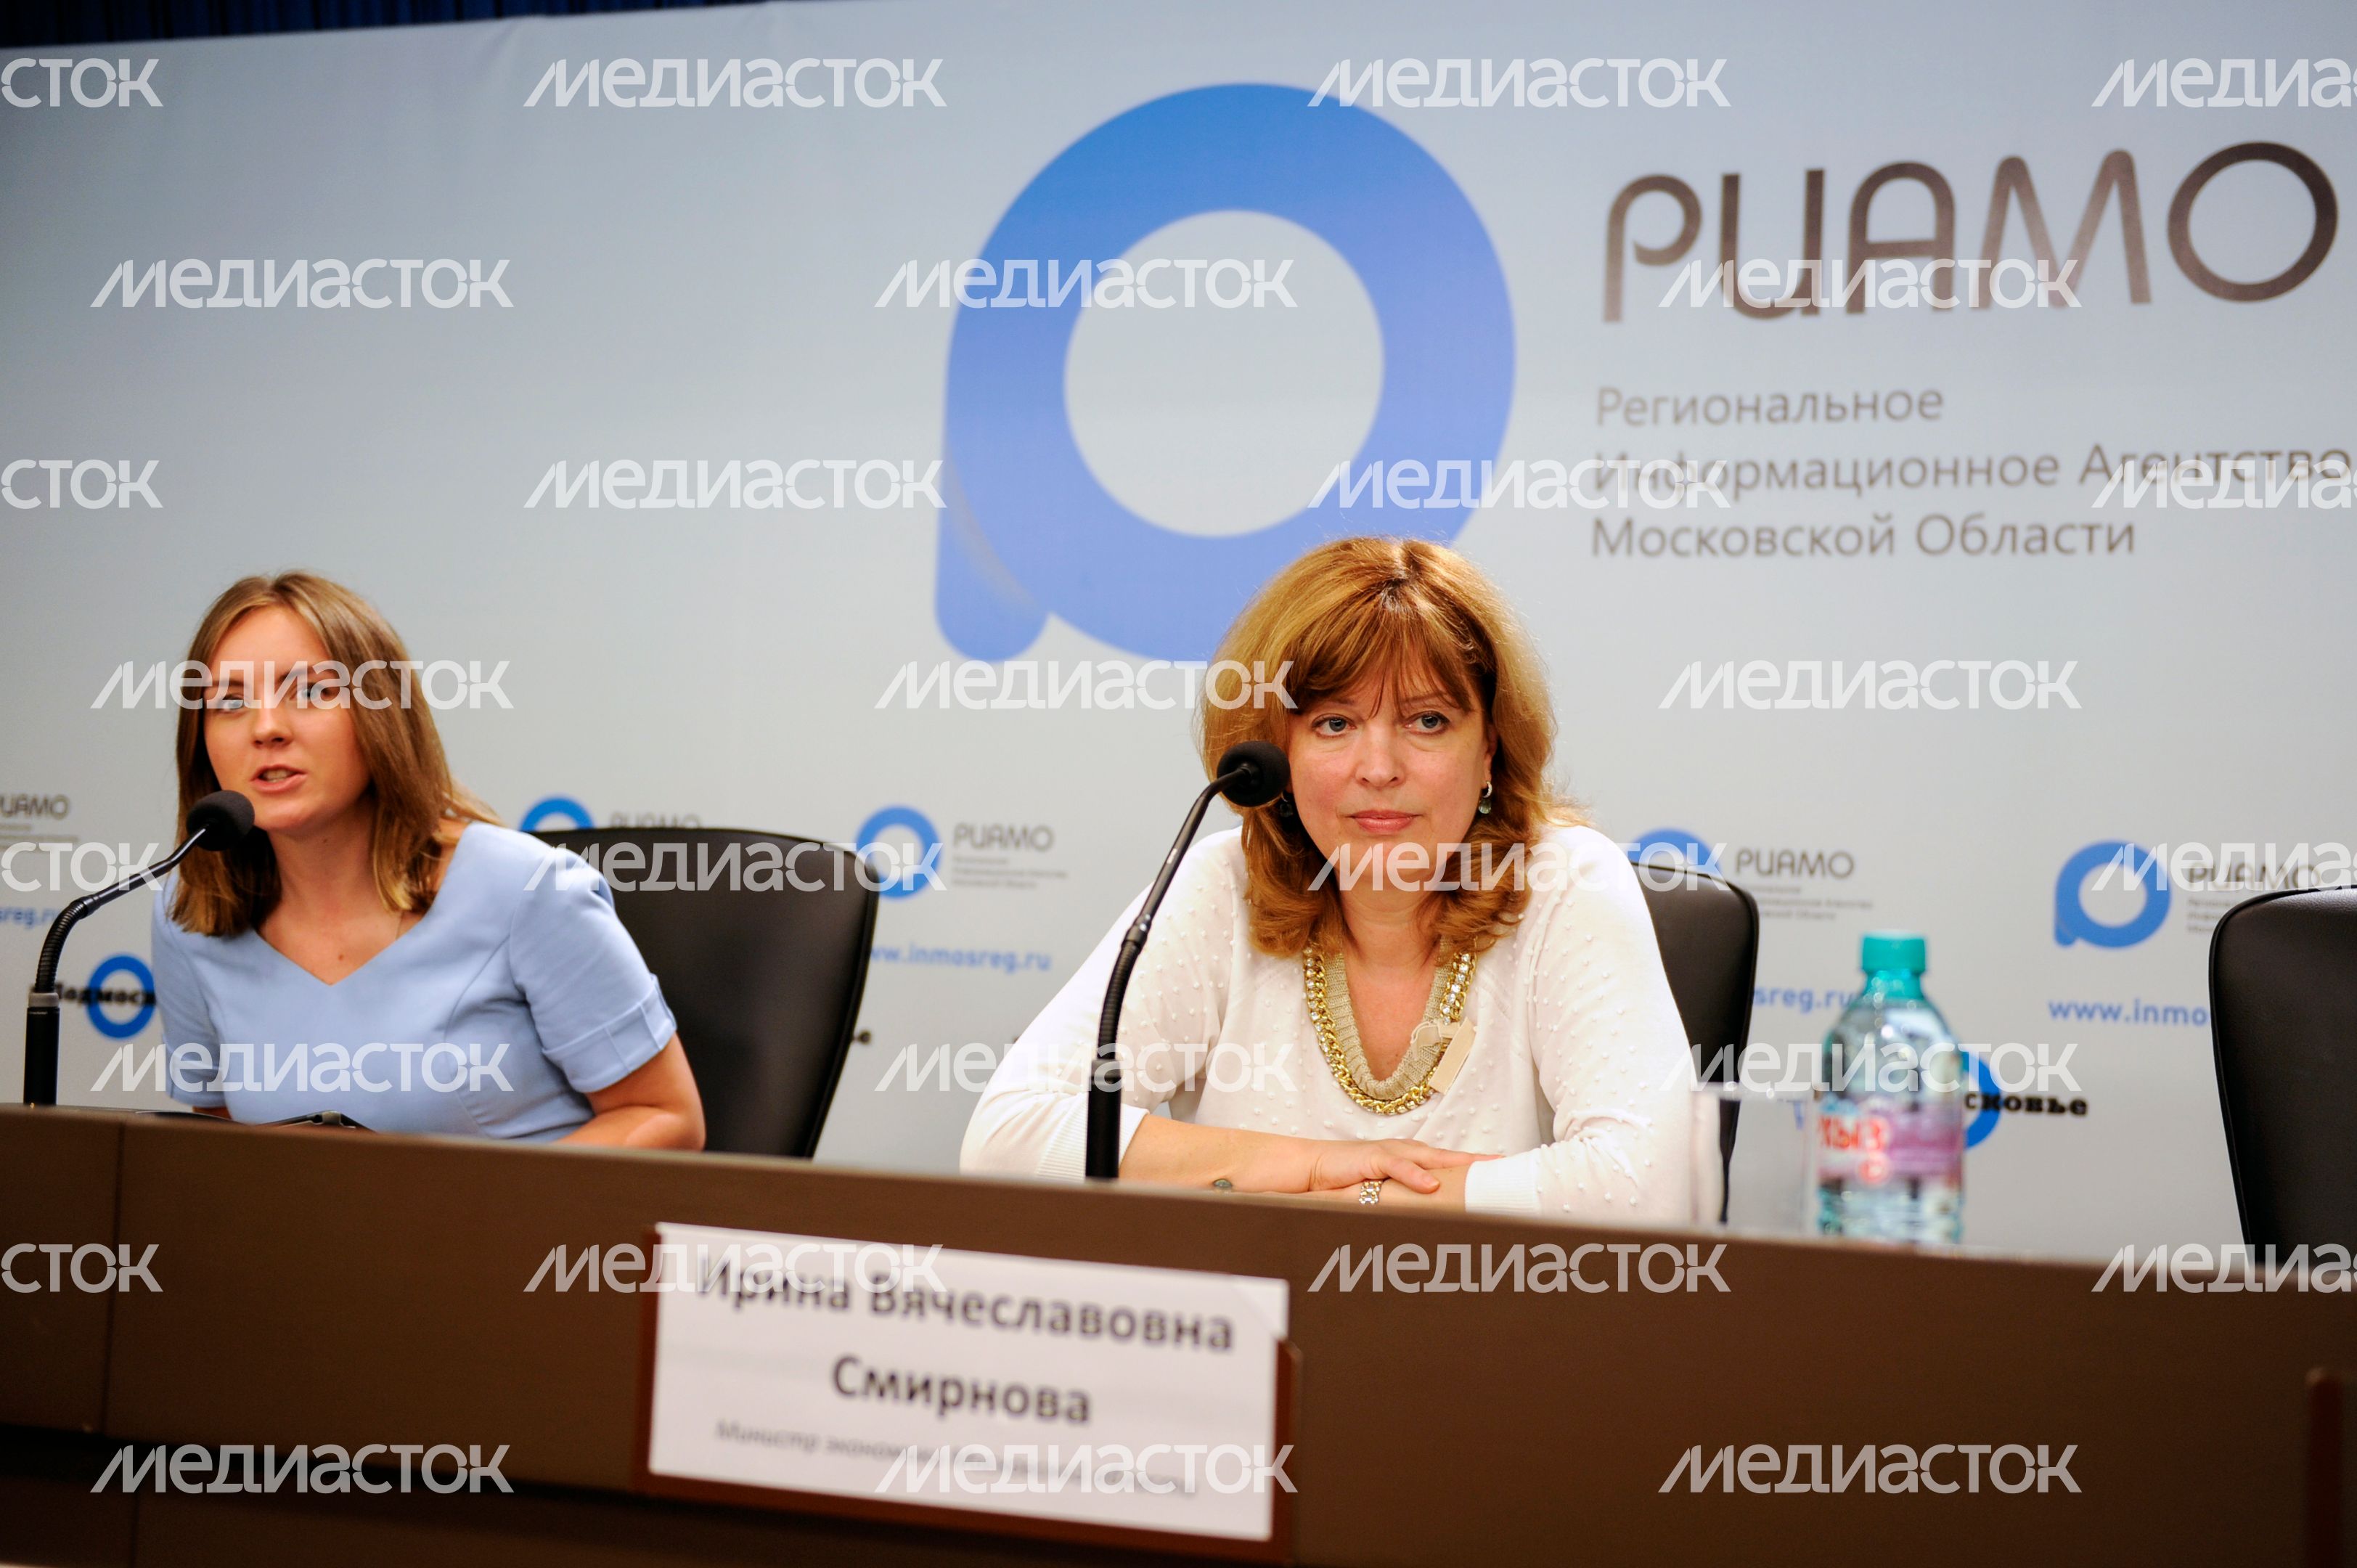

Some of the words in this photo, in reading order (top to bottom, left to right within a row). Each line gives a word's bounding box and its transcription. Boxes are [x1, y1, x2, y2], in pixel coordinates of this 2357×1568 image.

[1595, 386, 1945, 428] Региональное
[1593, 447, 2060, 502] Информационное
[2078, 443, 2353, 486] Агентство
[1590, 513, 1896, 559] Московской
[1915, 513, 2136, 556] Области
[0, 794, 70, 820] ИАМО
[1736, 847, 1855, 881] РИАМО
[870, 1270, 1235, 1353] Вячеславовна
[832, 1354, 1092, 1425] Смирнова
